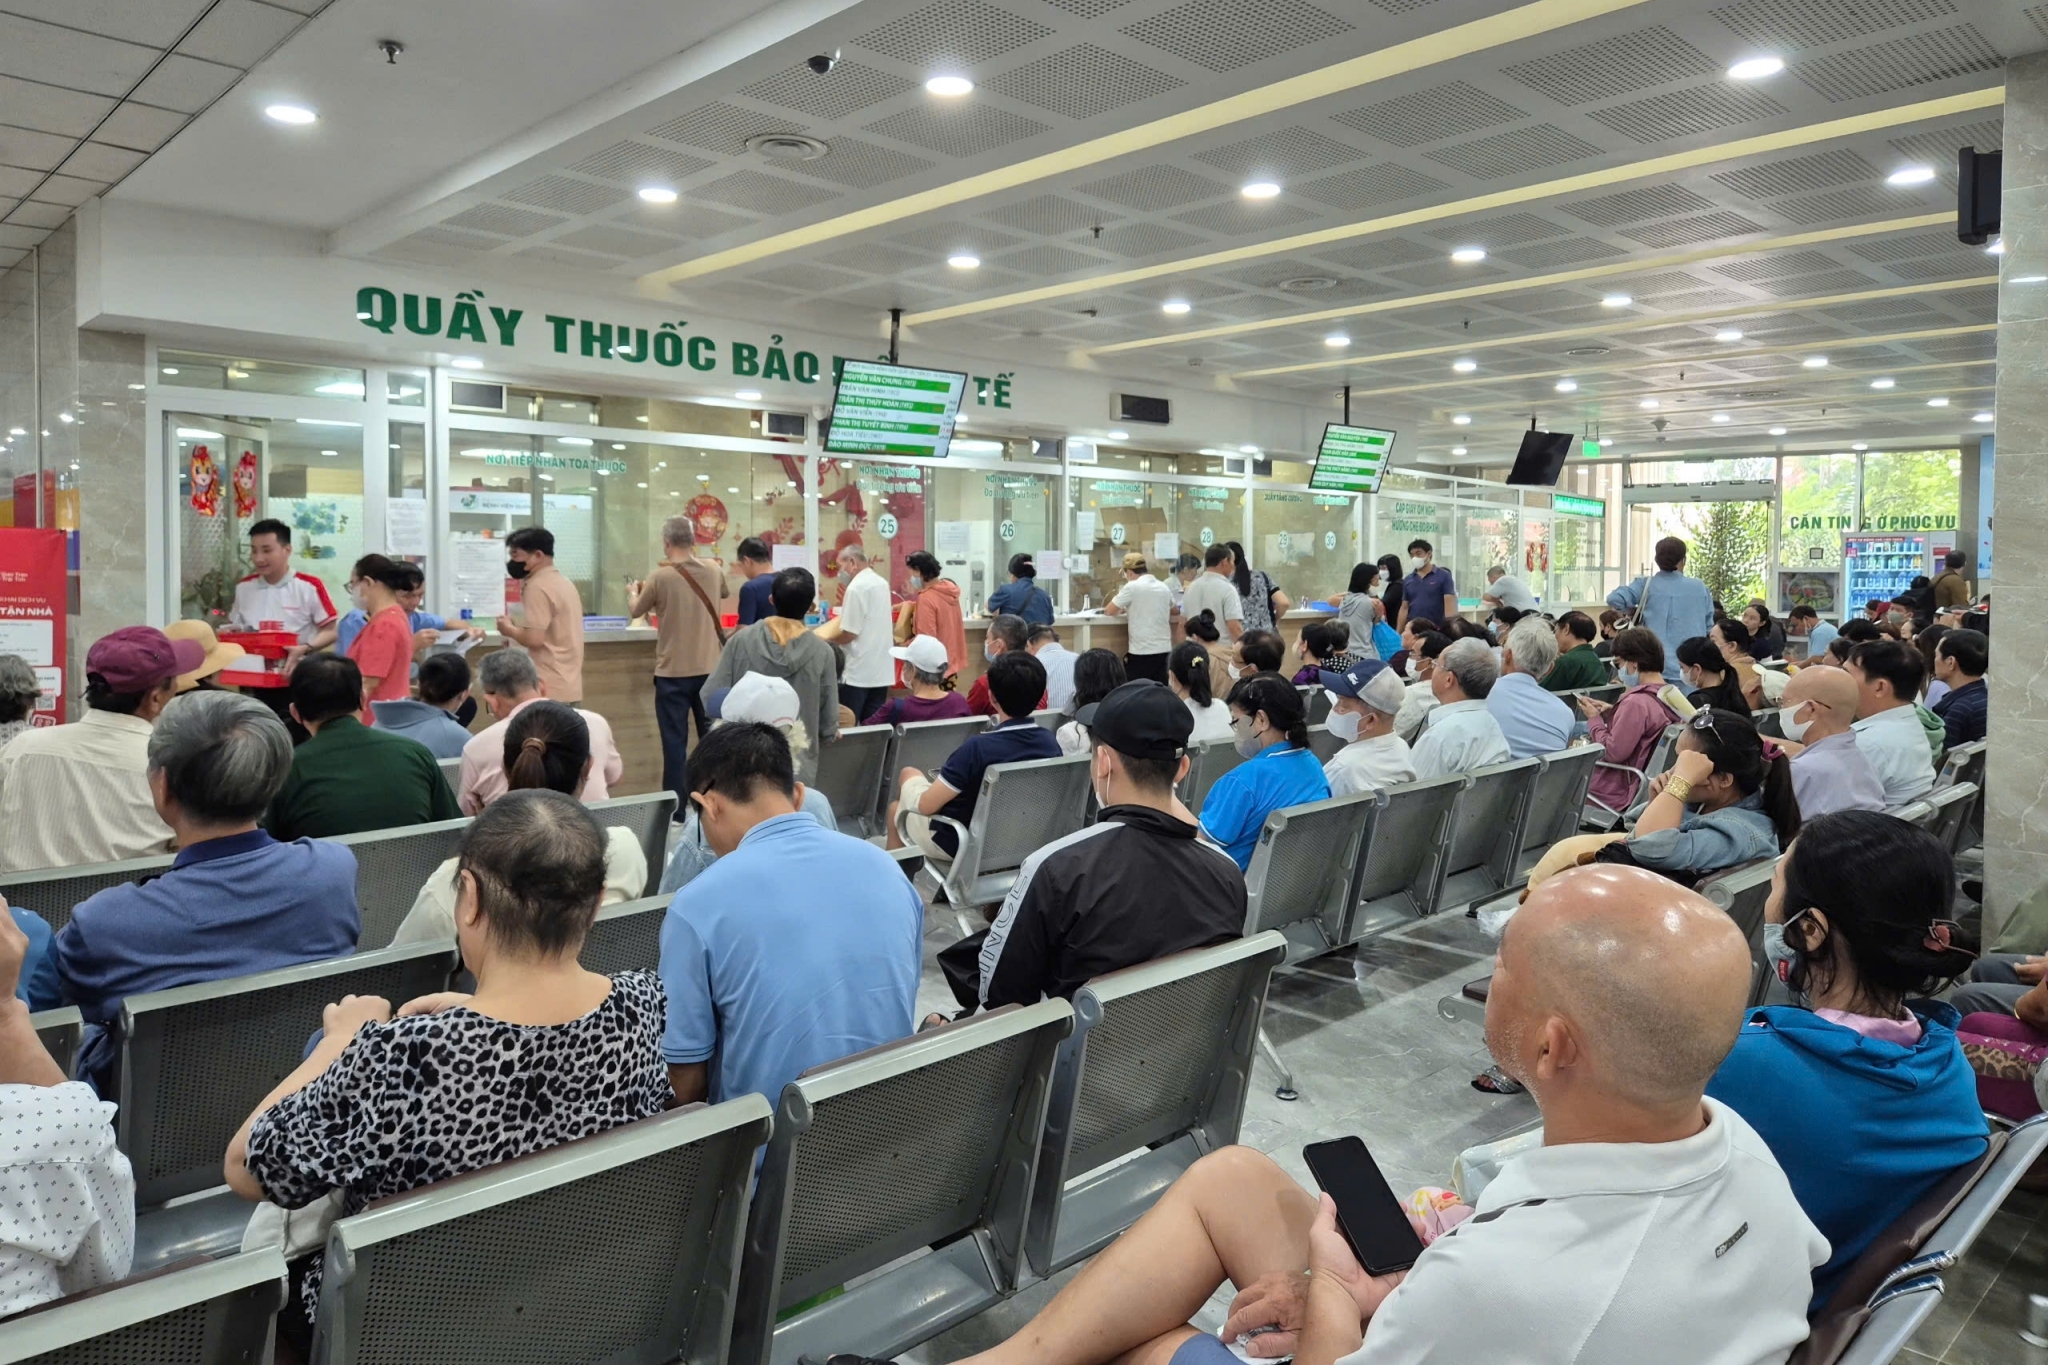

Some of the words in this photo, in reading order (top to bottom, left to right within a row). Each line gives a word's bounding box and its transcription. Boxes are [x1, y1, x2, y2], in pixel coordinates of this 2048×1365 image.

[356, 286, 524, 347] QUẦY
[545, 314, 716, 372] THUỐC
[732, 334, 819, 384] BẢO
[973, 372, 1016, 410] TẾ
[569, 458, 590, 470] TOA
[880, 519, 895, 533] 25
[1790, 514, 1822, 530] CĂN
[1827, 516, 1851, 529] TIN
[1001, 523, 1014, 537] 26
[1113, 527, 1123, 540] 27
[1202, 531, 1212, 543] 28
